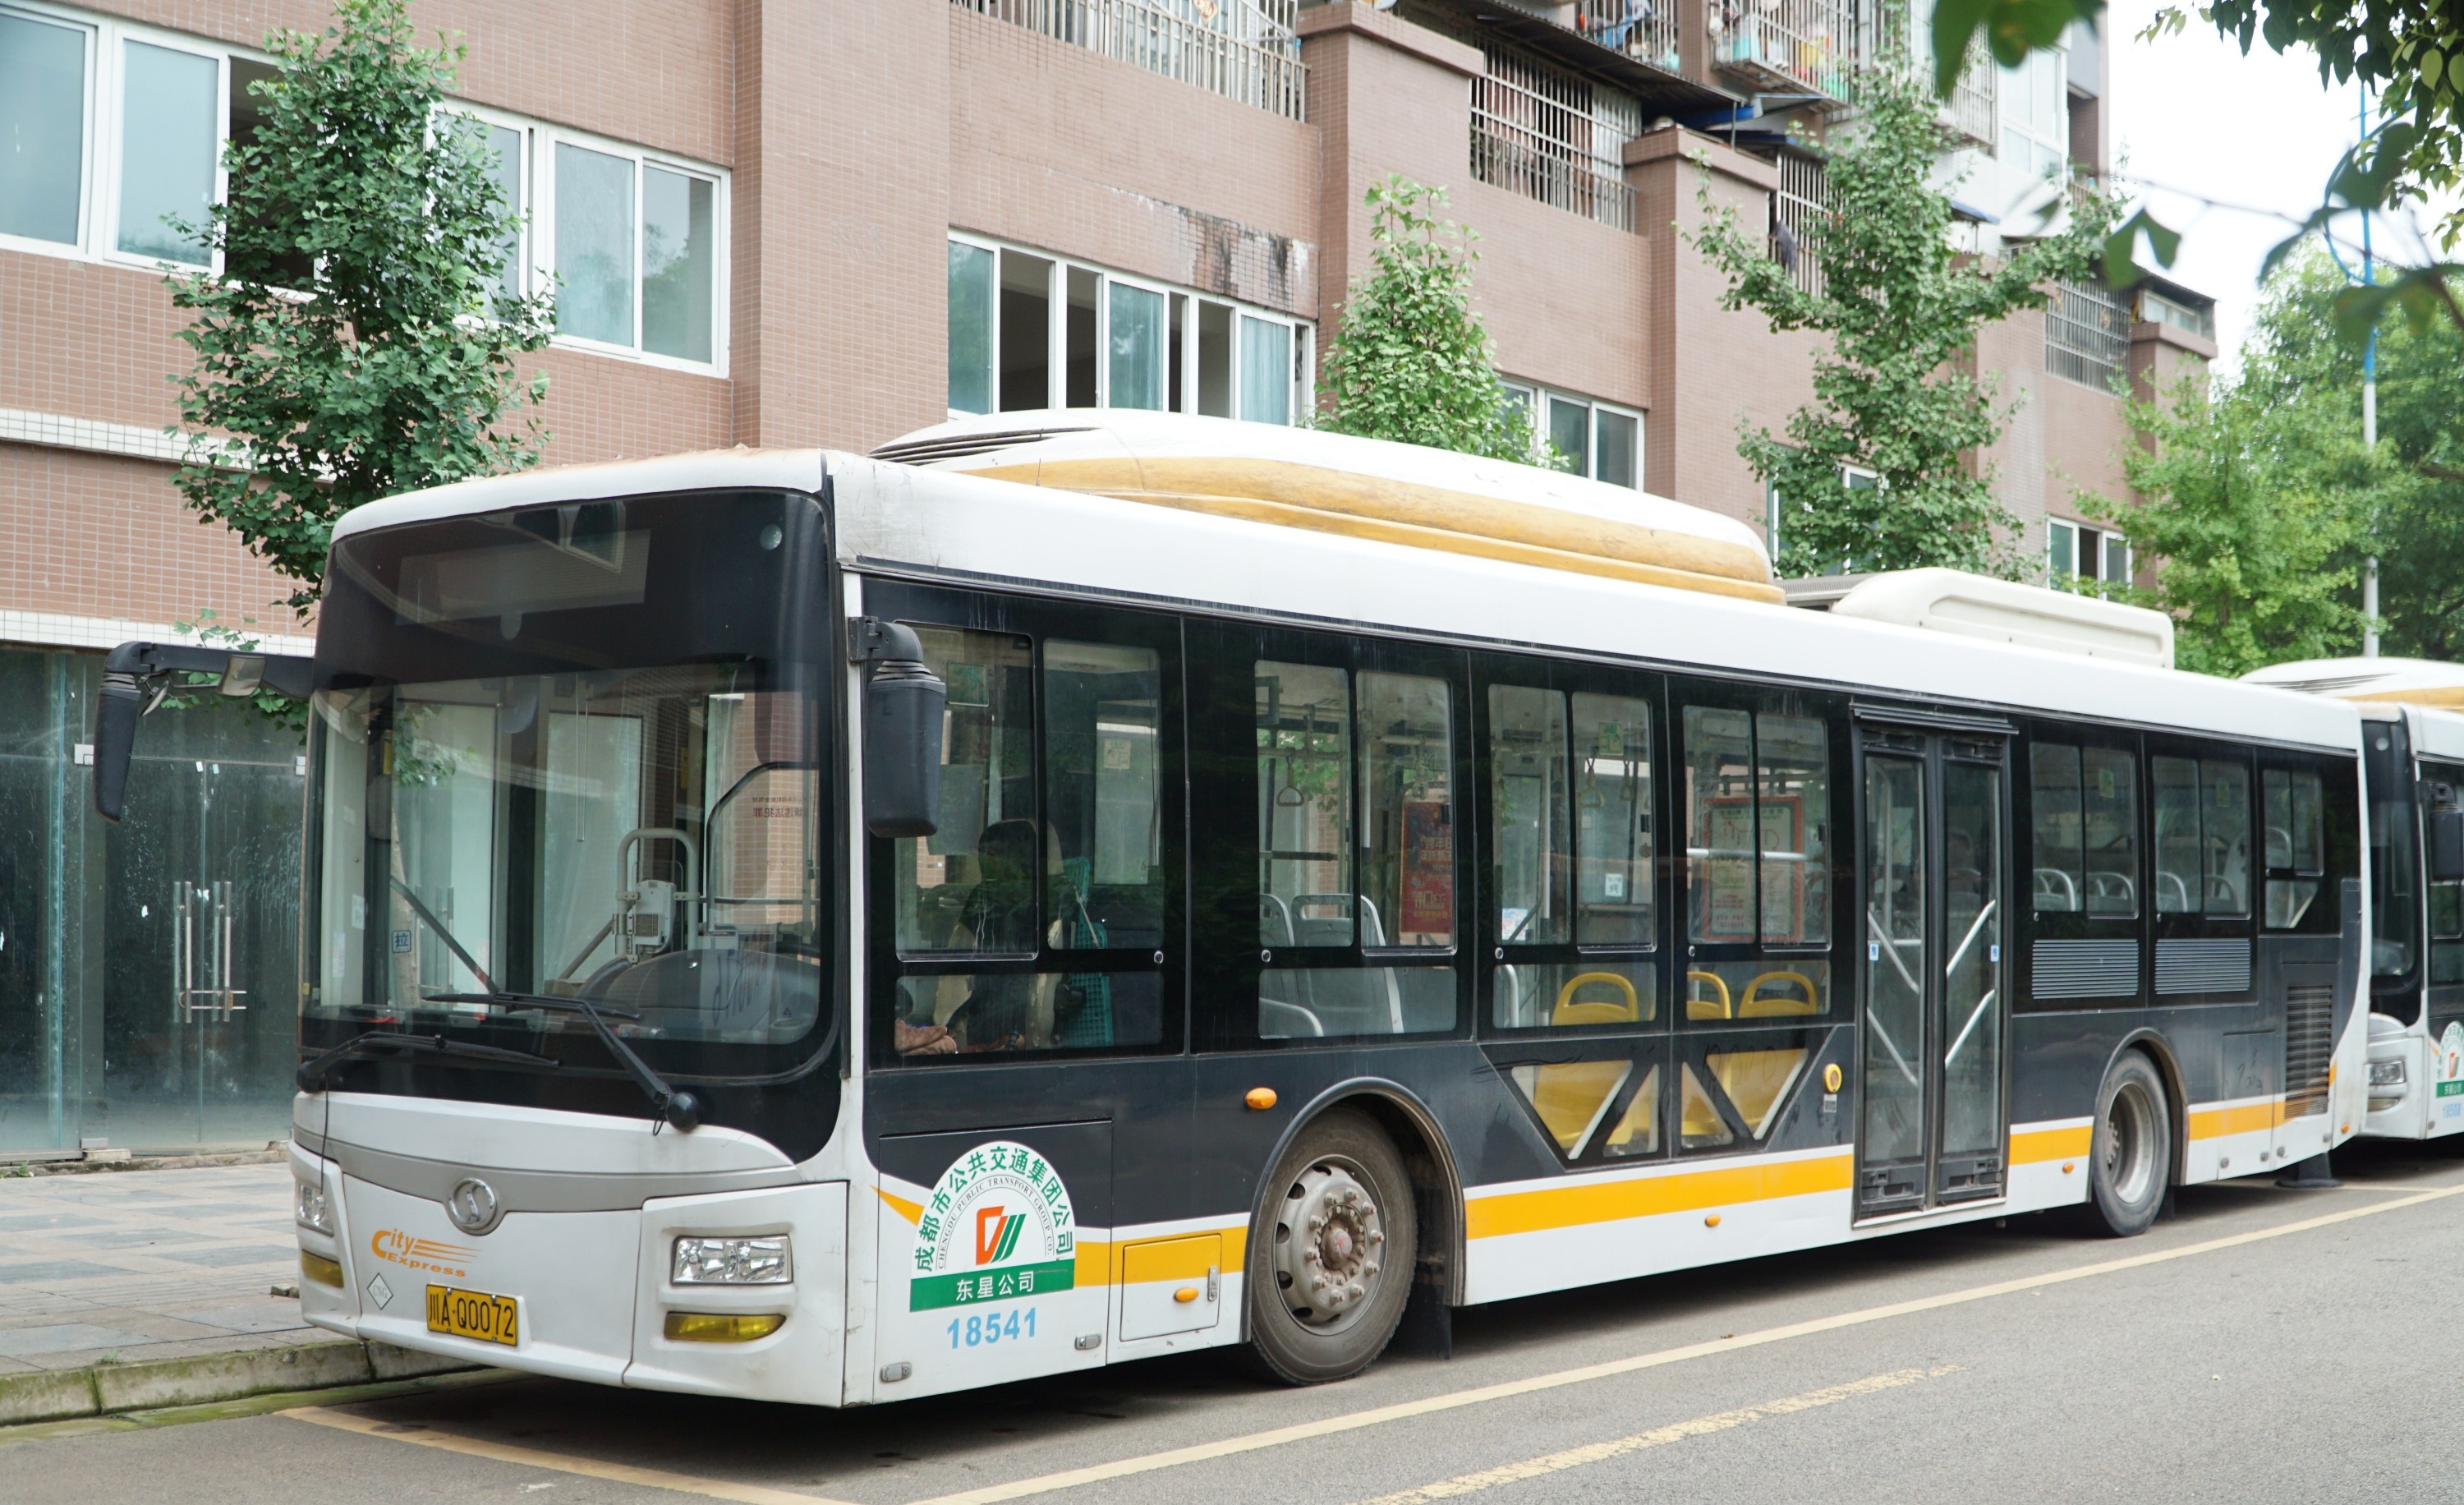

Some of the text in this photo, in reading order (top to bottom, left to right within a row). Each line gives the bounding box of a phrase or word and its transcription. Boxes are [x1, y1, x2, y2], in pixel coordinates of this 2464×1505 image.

[915, 1146, 1073, 1272] 成都市公共交通集团公司
[938, 1213, 958, 1269] CHENGDU
[957, 1182, 985, 1212] PUBLIC
[988, 1177, 1034, 1198] TRANSPORT
[1034, 1198, 1050, 1231] GROUP
[371, 1228, 416, 1259] City
[386, 1251, 467, 1277] Express
[373, 1285, 388, 1300] CNG
[955, 1271, 1034, 1301] 东星公司
[947, 1307, 1036, 1349] 18541
